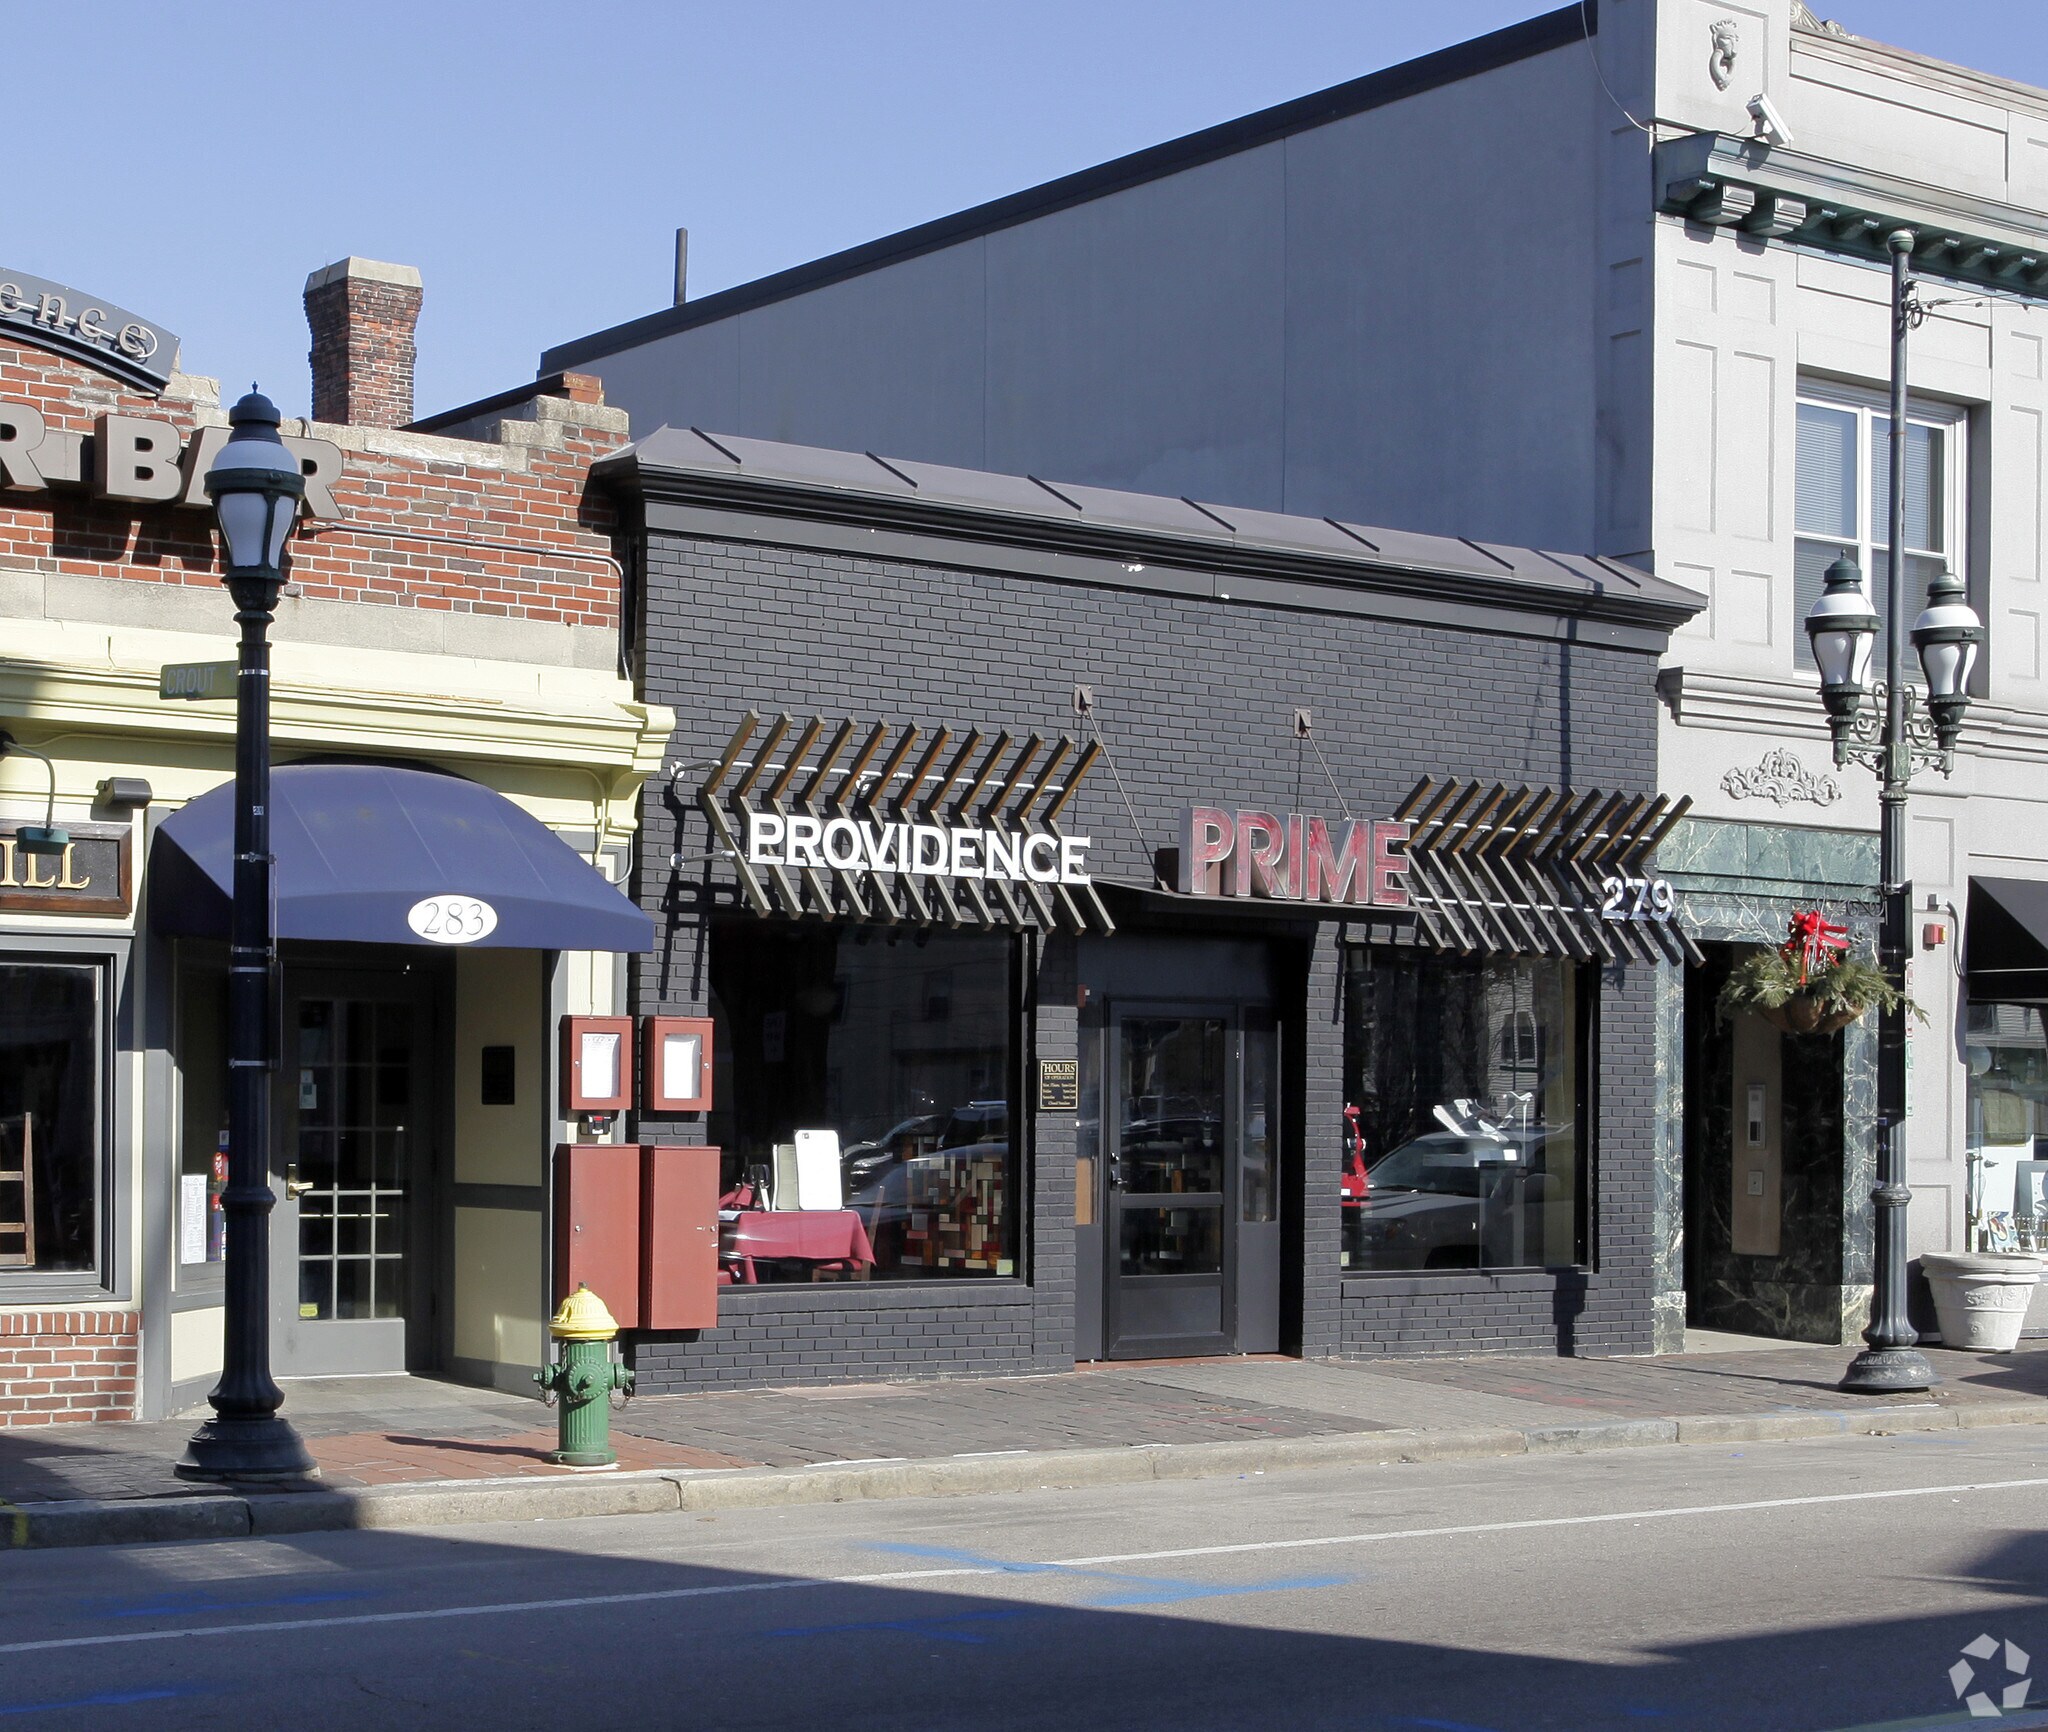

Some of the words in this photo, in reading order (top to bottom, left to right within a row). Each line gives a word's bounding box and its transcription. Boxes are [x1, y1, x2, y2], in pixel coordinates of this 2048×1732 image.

[166, 667, 216, 695] CROUT
[748, 812, 1092, 887] PROVIDENCE
[1178, 805, 1411, 908] PRIME
[423, 902, 483, 935] 283
[1601, 876, 1674, 923] 279
[1044, 1063, 1075, 1073] HOURS
